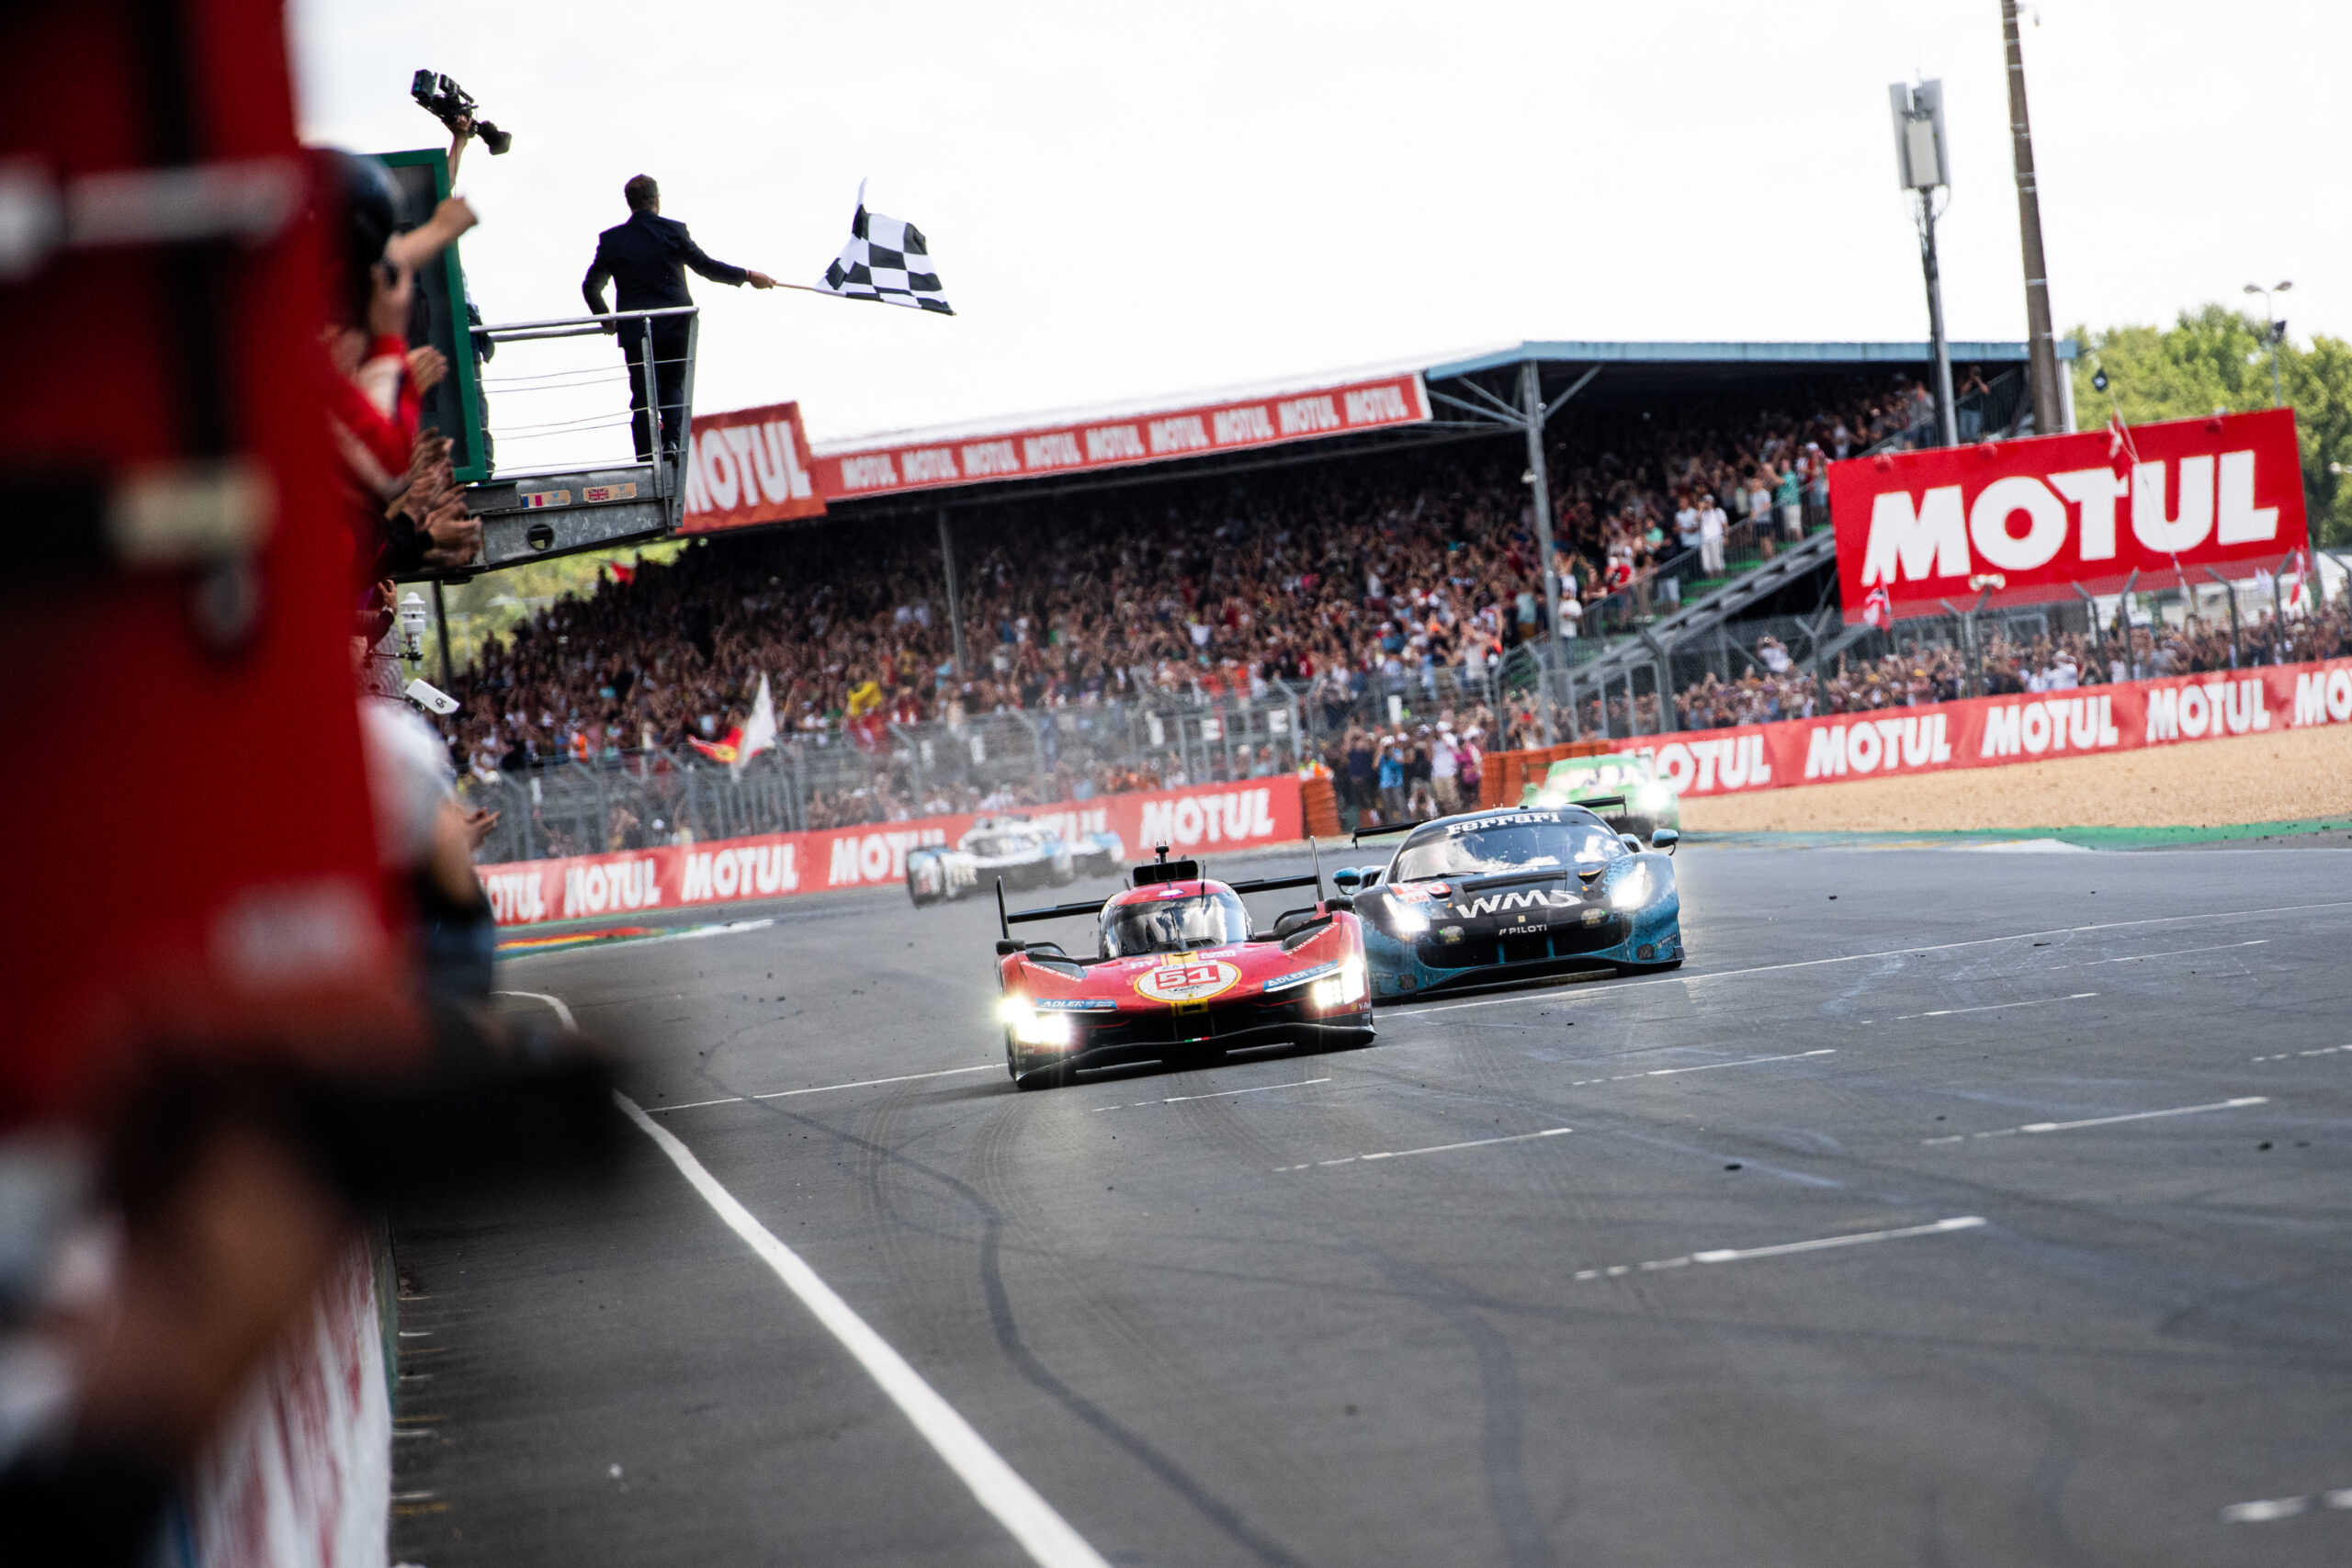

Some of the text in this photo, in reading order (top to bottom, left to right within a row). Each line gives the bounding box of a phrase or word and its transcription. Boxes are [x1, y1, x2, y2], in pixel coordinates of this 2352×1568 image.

[1149, 415, 1210, 455] MOTUL
[1213, 405, 1275, 443] MOTUL
[1278, 395, 1340, 435] MOTUL
[1344, 385, 1409, 424] MOTUL
[1860, 450, 2279, 587] MOTUL
[1804, 713, 1951, 779] MOTUL
[1981, 694, 2119, 758] MOTUL
[2146, 678, 2271, 743] MOTUL
[2294, 669, 2352, 726] MO
[1446, 813, 1561, 836] Ferrari
[485, 872, 545, 922] OTUL
[563, 858, 662, 918] MOTUL
[681, 842, 799, 903] MOTUL
[1139, 787, 1275, 850] MOTUL
[1159, 967, 1216, 987] 51
[1268, 970, 1309, 988] ADLER
[1042, 999, 1084, 1009] ADLER
